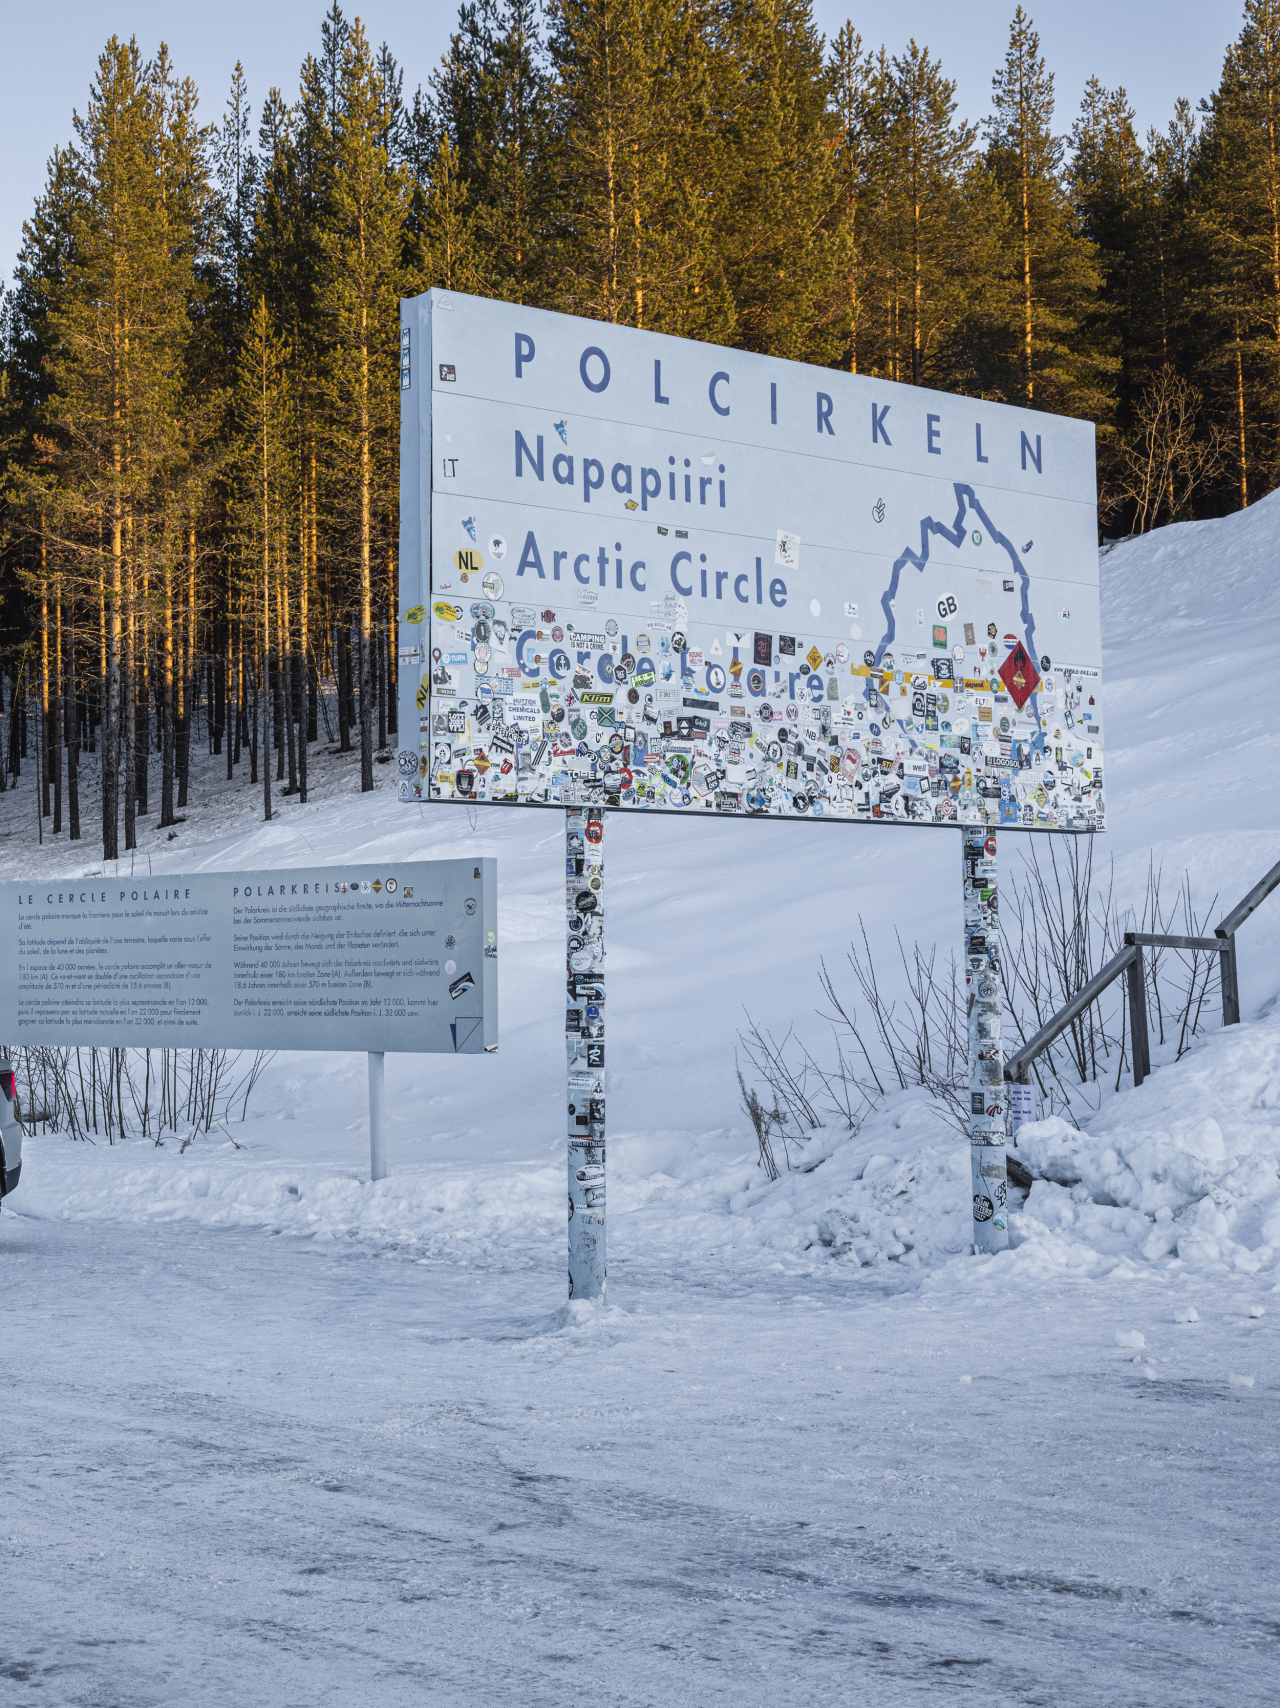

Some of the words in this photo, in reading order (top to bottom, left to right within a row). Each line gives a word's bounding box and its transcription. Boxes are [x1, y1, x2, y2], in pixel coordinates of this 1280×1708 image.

[514, 332, 1043, 475] POLCIRKELN
[514, 429, 726, 512] Napapiiri
[458, 551, 479, 572] NL
[515, 530, 647, 592] Arctic
[670, 551, 788, 608] Circle
[937, 595, 957, 619] GB
[571, 633, 605, 642] CAMPING
[582, 694, 611, 703] Klim
[805, 729, 817, 741] NB
[993, 757, 1021, 768] LOGOSOL
[18, 894, 33, 904] LE
[47, 892, 106, 904] CERCLE
[120, 889, 190, 901] POLAIRE
[233, 882, 340, 897] POLARKREIS
